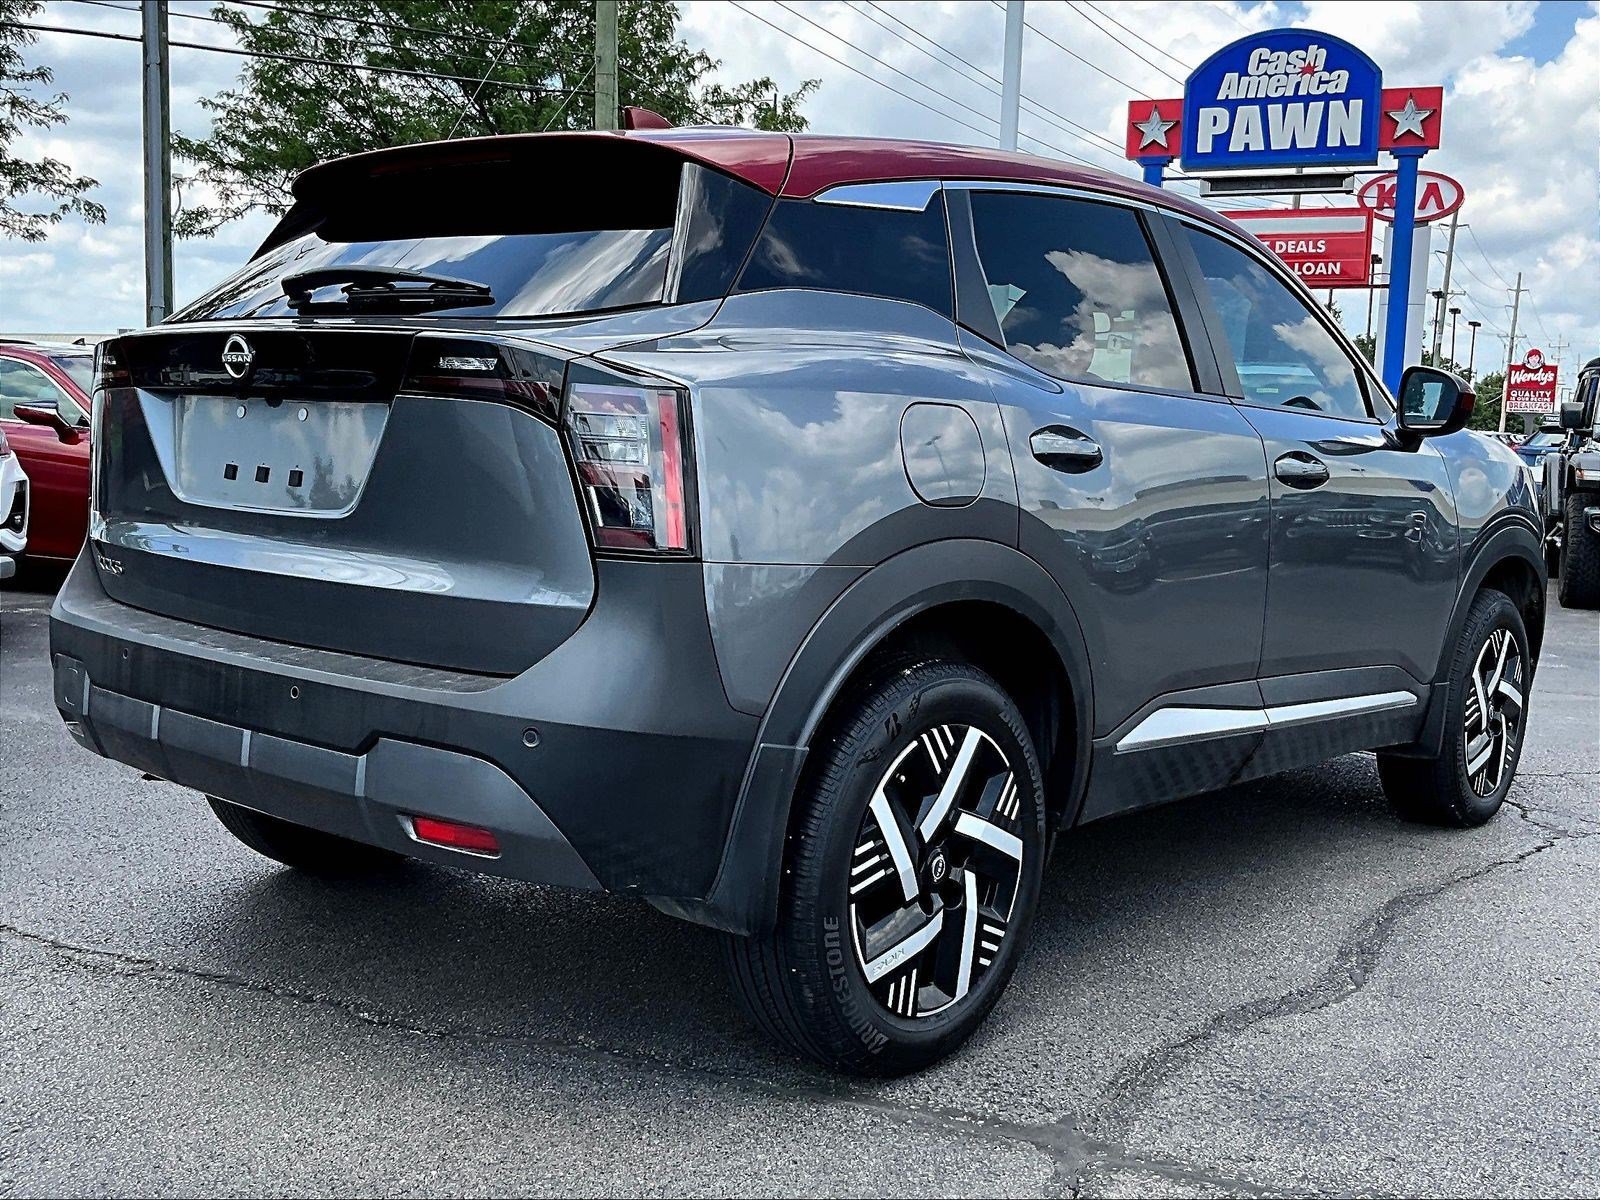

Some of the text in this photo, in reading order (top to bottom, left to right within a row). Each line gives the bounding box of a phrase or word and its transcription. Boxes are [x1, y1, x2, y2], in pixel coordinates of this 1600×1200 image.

[1248, 44, 1327, 76] Cash
[1216, 69, 1350, 101] America
[1196, 99, 1363, 153] PAWN
[1375, 182, 1445, 211] KA
[1275, 240, 1326, 254] DEALS
[1294, 261, 1341, 276] LOAN
[1510, 368, 1554, 385] Wendy's
[1510, 390, 1551, 398] QUALITY
[823, 915, 890, 1056] BRIDGESTONE
